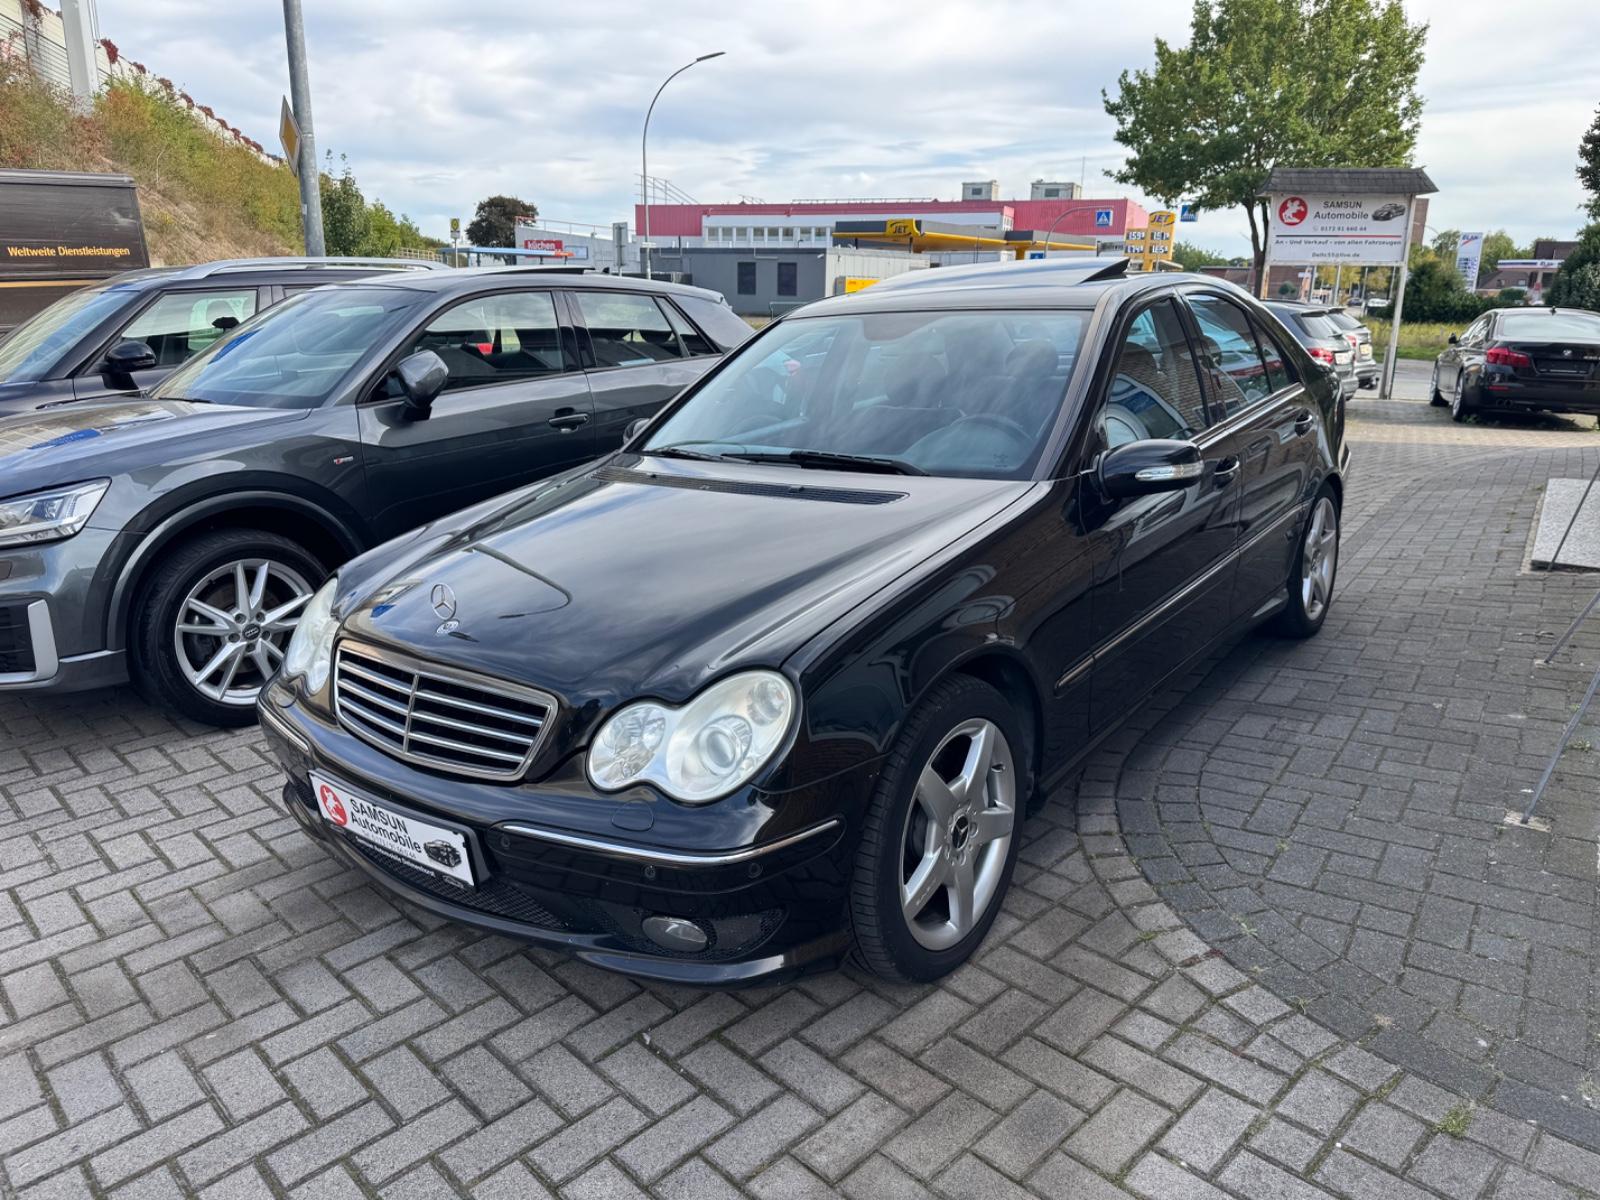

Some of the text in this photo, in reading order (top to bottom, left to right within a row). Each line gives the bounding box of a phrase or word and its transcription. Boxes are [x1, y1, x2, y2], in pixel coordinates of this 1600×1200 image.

[1323, 201, 1362, 209] SAMSUN
[1313, 211, 1369, 220] Automobile
[893, 224, 909, 234] JET
[7, 246, 131, 258] Weltweite Dienstleistungen
[350, 798, 409, 834] SAMSUN
[351, 811, 422, 853] Automobile
